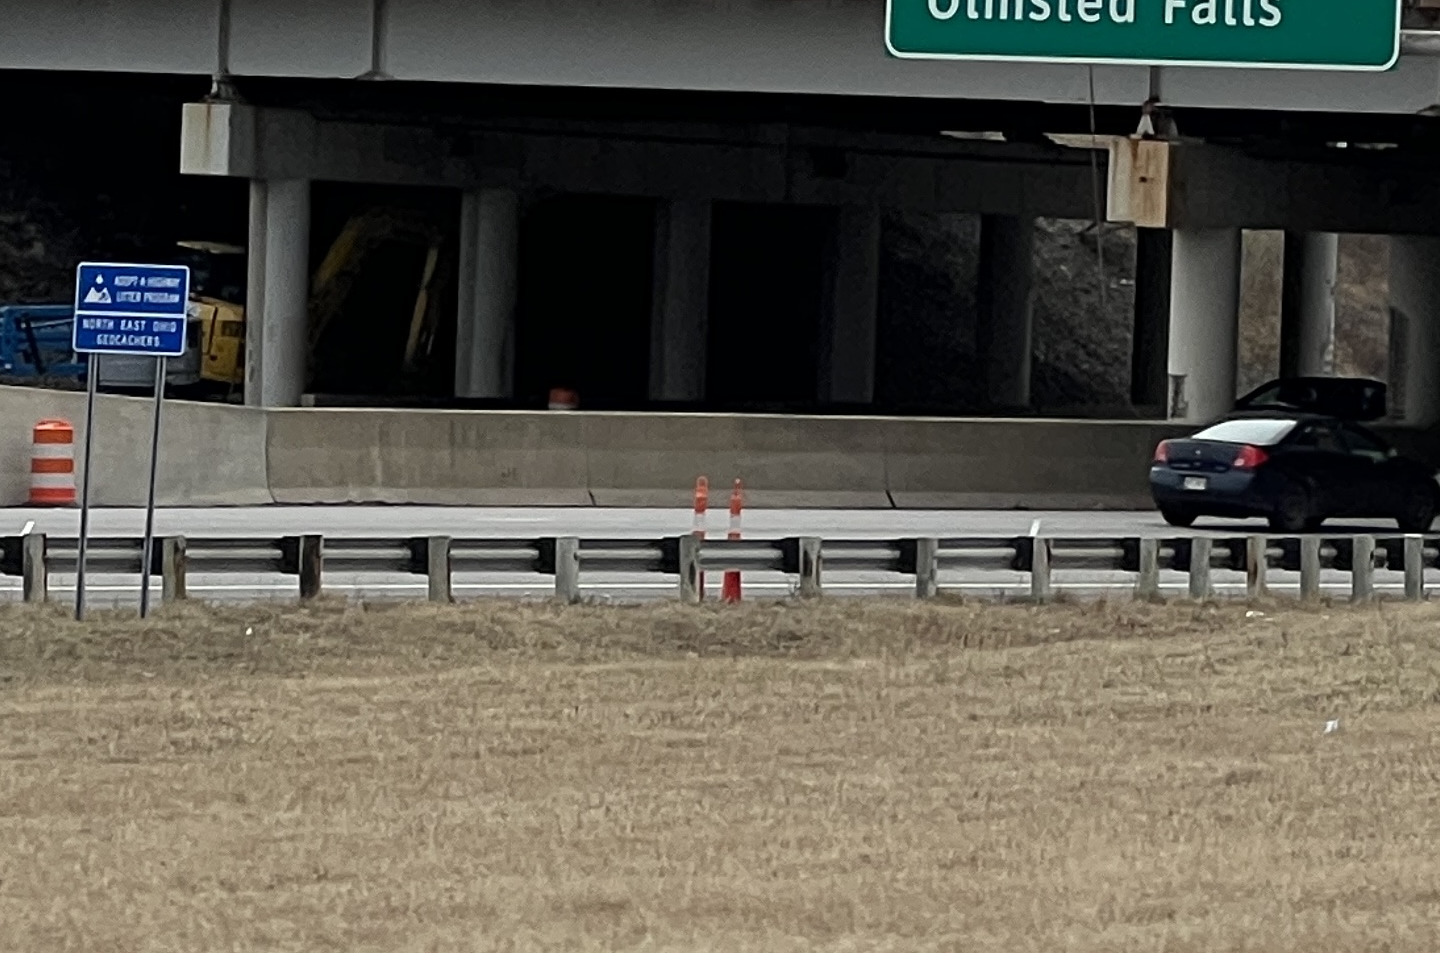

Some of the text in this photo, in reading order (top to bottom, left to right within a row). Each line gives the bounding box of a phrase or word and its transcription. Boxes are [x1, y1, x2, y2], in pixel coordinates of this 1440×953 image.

[82, 318, 114, 330] NORTH
[120, 318, 146, 332] EAST
[96, 333, 160, 347] GEOCACHERS
